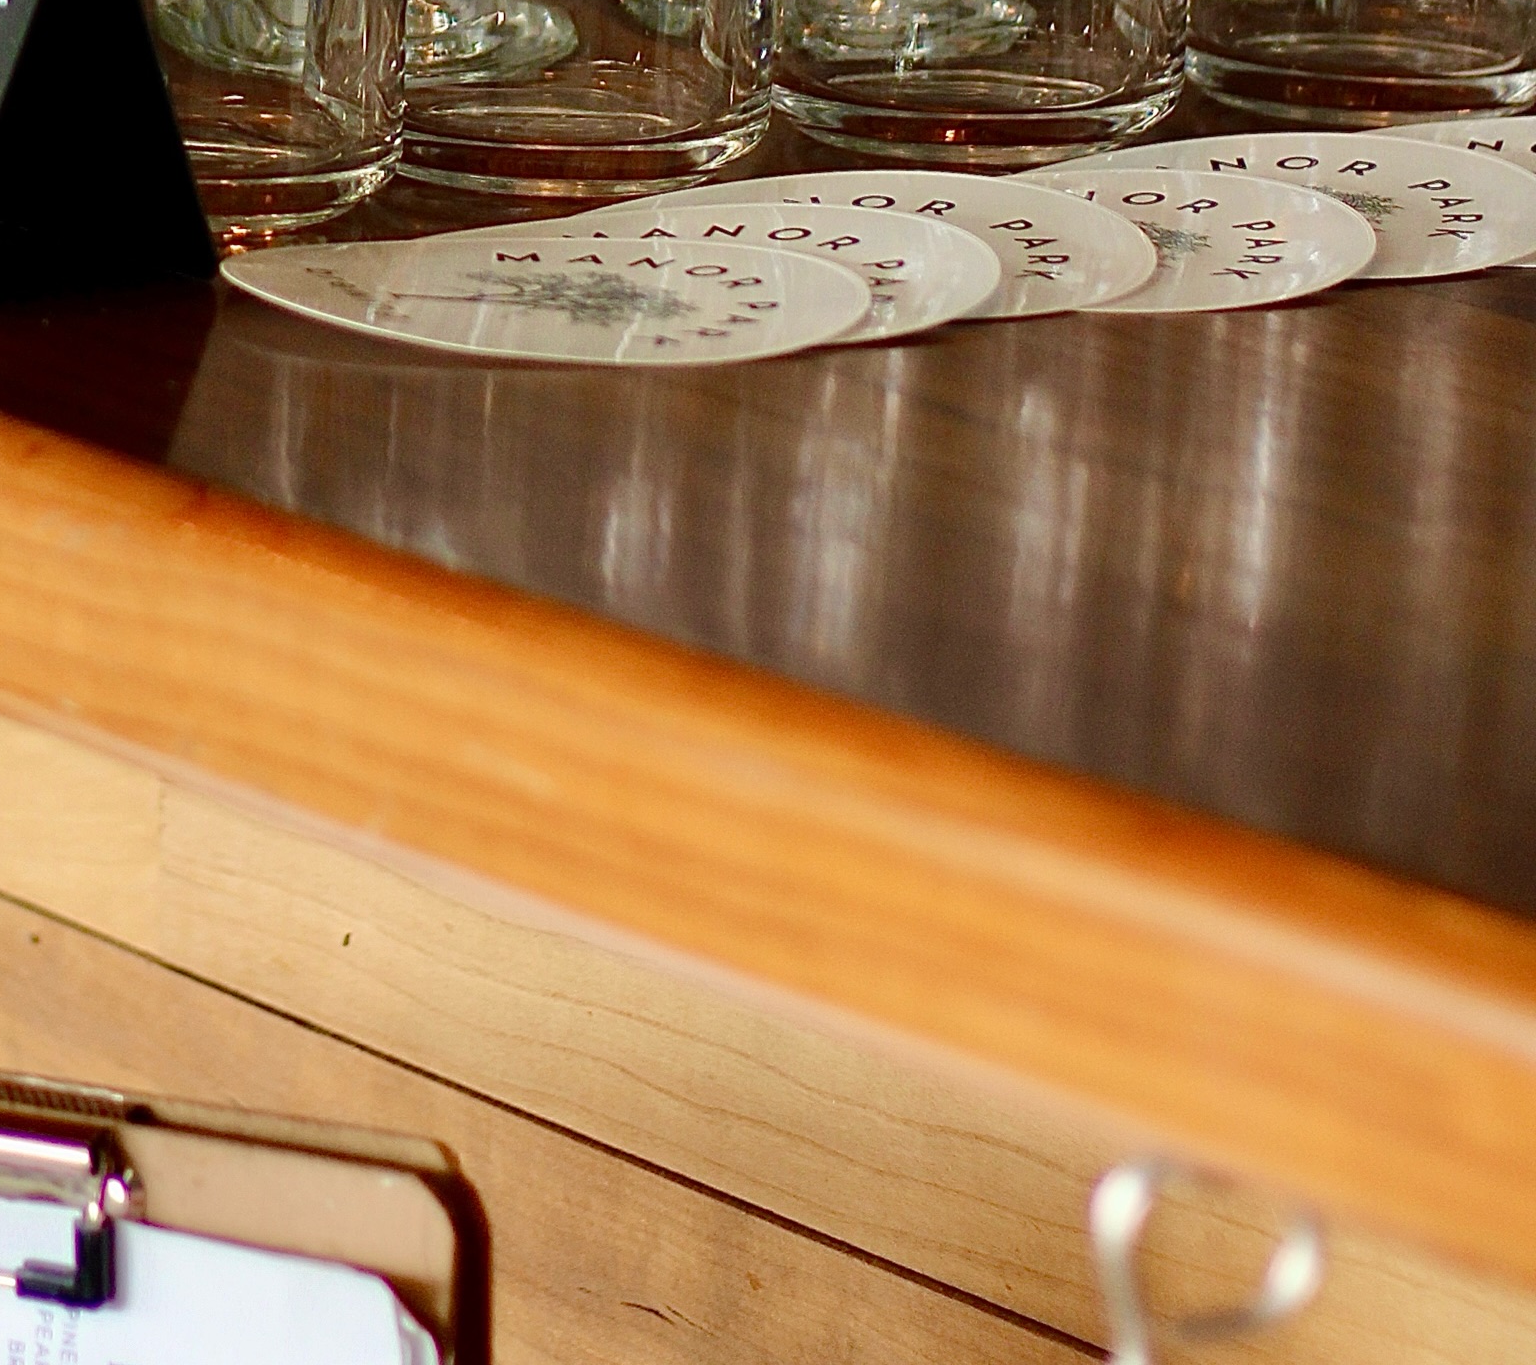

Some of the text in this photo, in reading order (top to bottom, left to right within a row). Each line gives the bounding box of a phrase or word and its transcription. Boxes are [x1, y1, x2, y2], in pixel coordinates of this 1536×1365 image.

[562, 224, 860, 251] ANOR
[1407, 178, 1484, 241] PARK
[495, 252, 762, 289] MANOR
[990, 218, 1070, 280] PARK
[1211, 219, 1288, 280] PARK
